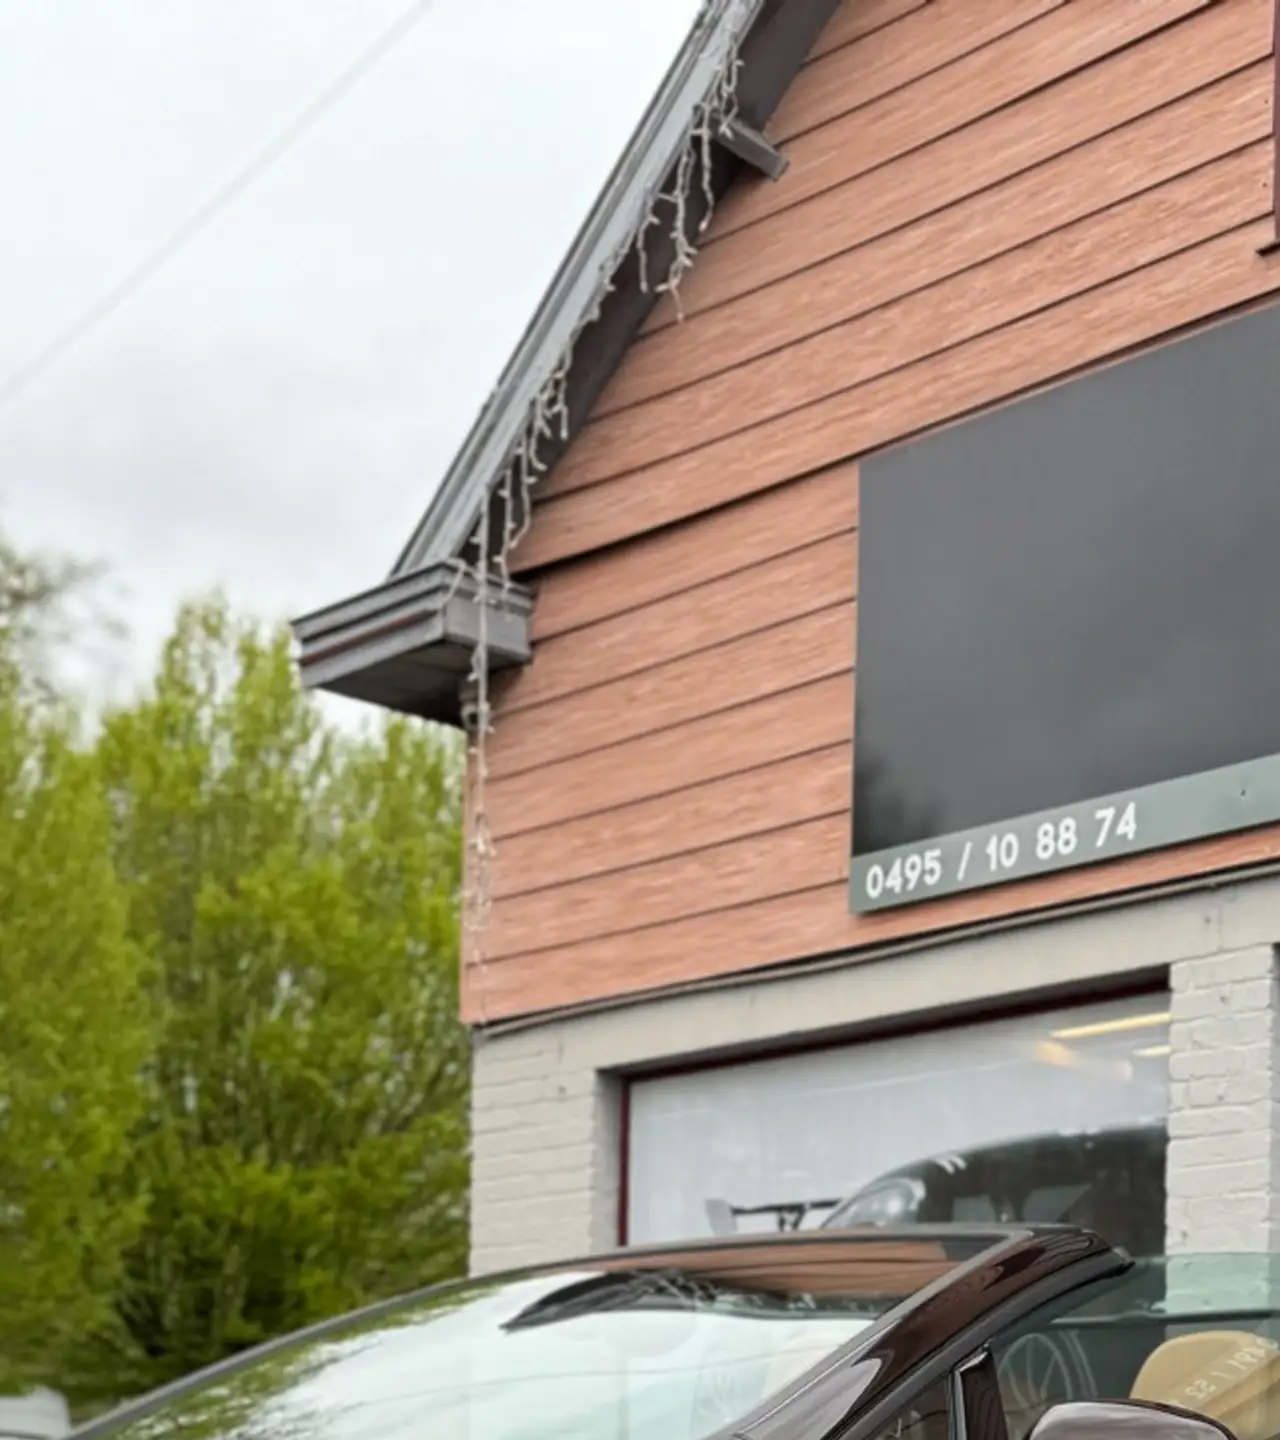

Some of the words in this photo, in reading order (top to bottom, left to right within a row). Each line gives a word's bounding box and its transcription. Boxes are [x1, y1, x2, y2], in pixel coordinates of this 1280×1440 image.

[865, 848, 943, 899] 0495
[957, 841, 973, 882] /
[986, 833, 1020, 873] 10
[1035, 818, 1079, 861] 88
[1095, 802, 1139, 848] 74
